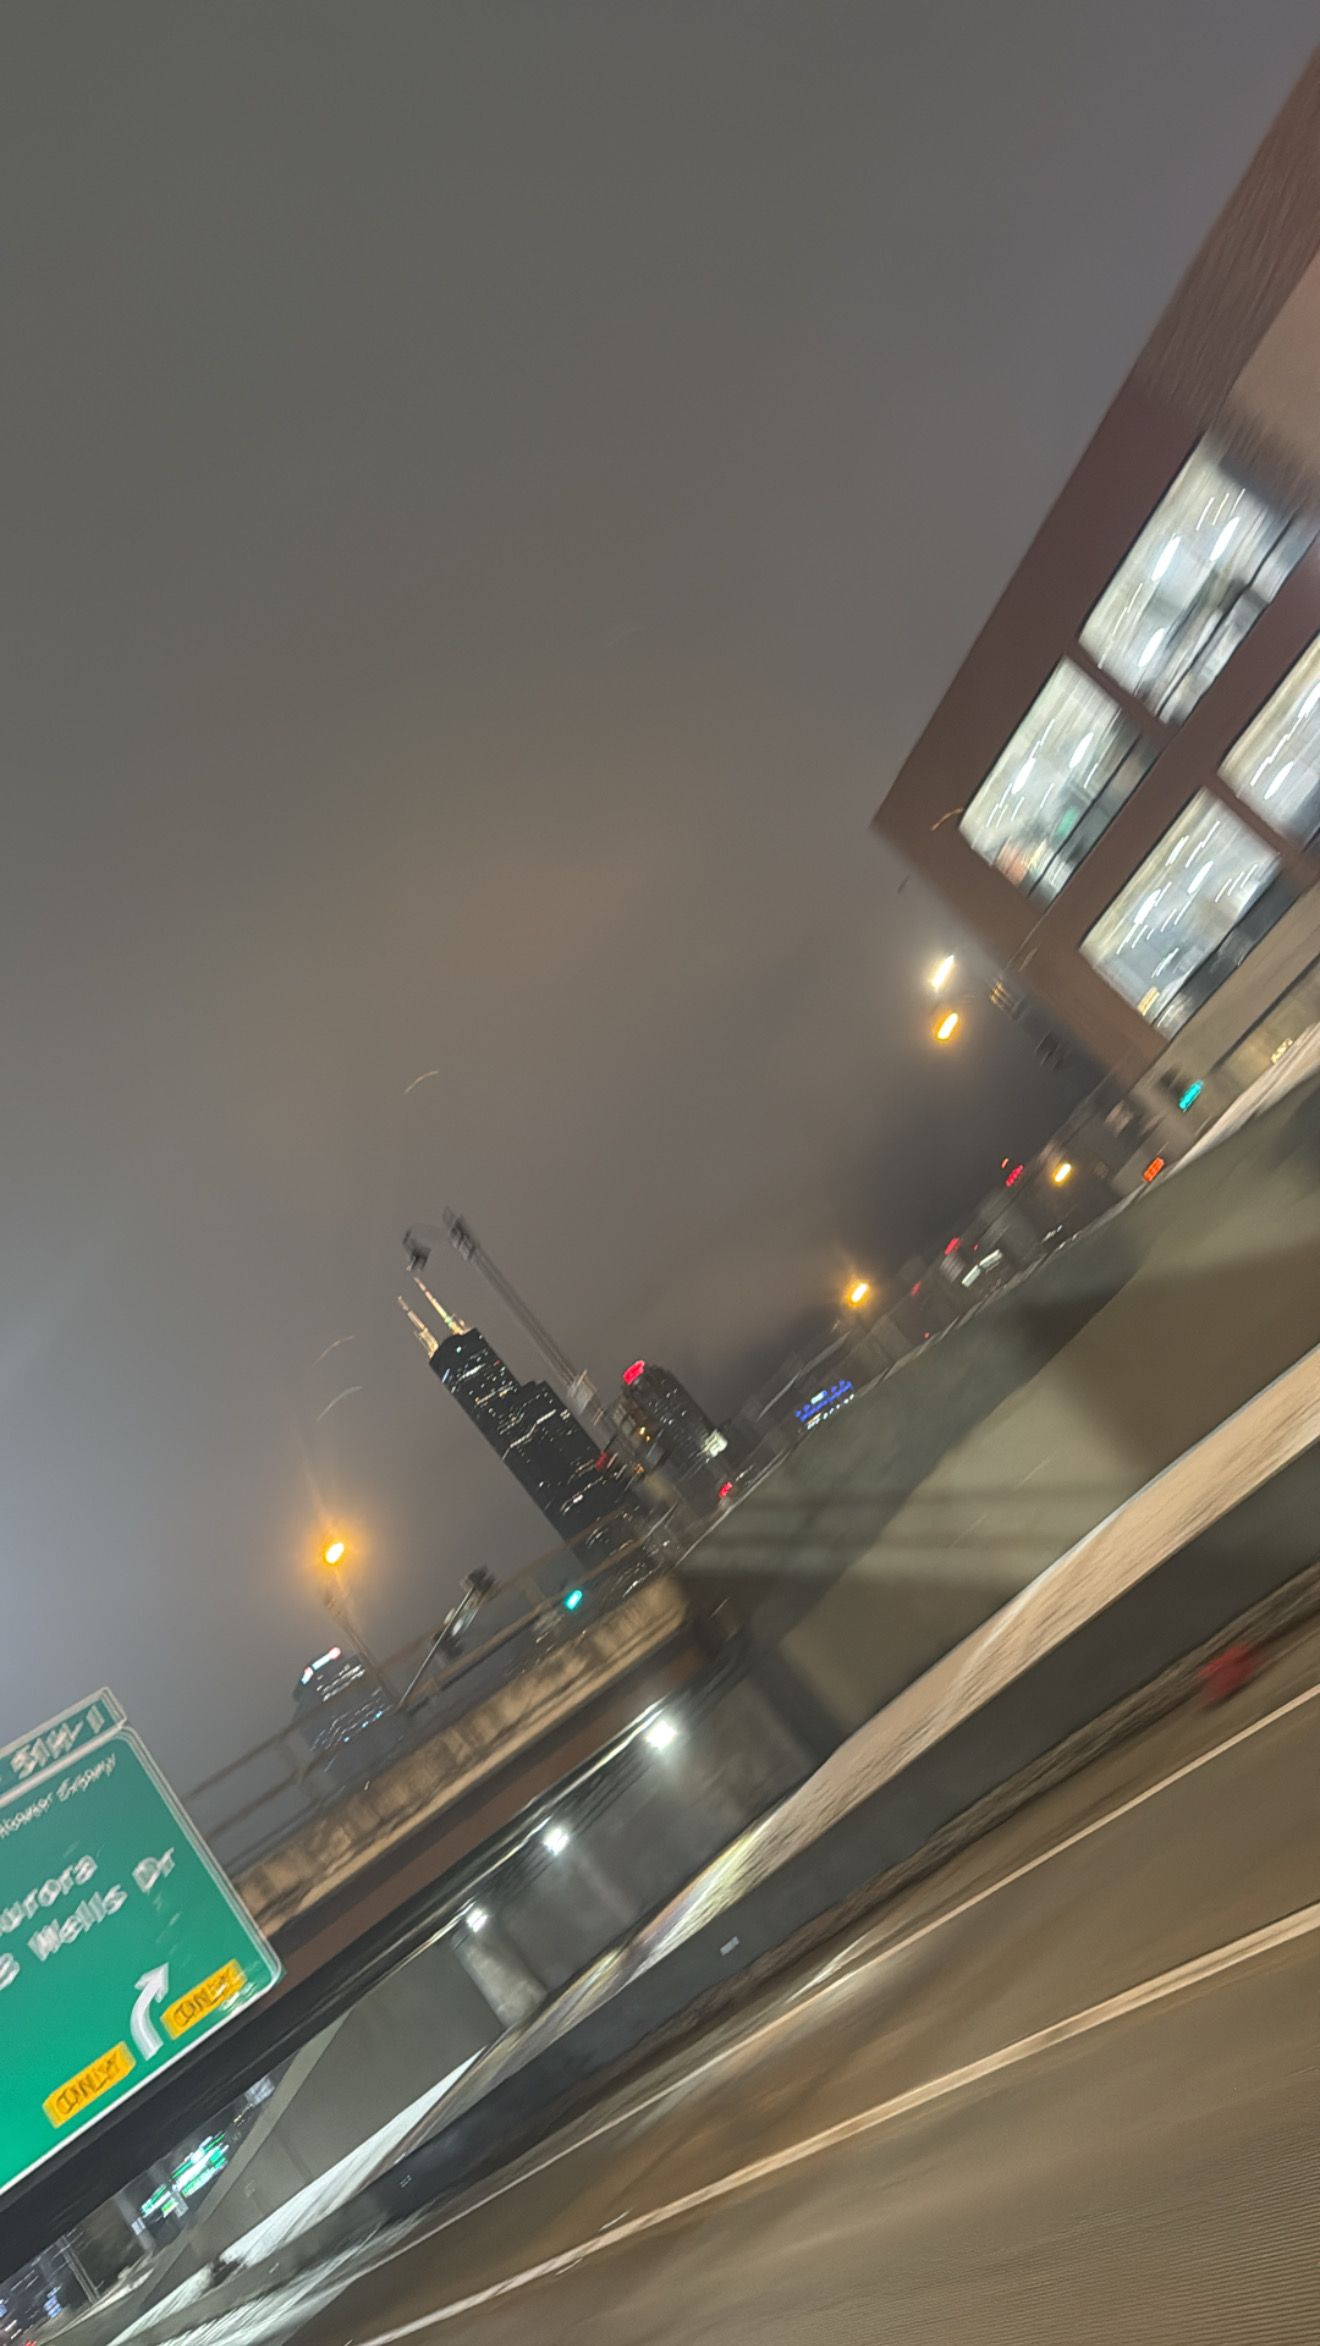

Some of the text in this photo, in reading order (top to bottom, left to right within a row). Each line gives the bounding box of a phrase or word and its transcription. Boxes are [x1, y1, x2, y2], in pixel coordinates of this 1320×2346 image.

[0, 1855, 98, 1937] urora
[27, 1884, 128, 1963] Wells
[131, 1847, 176, 1894] Dr
[172, 1967, 233, 2028] ONLY
[55, 2052, 121, 2116] ONLY
